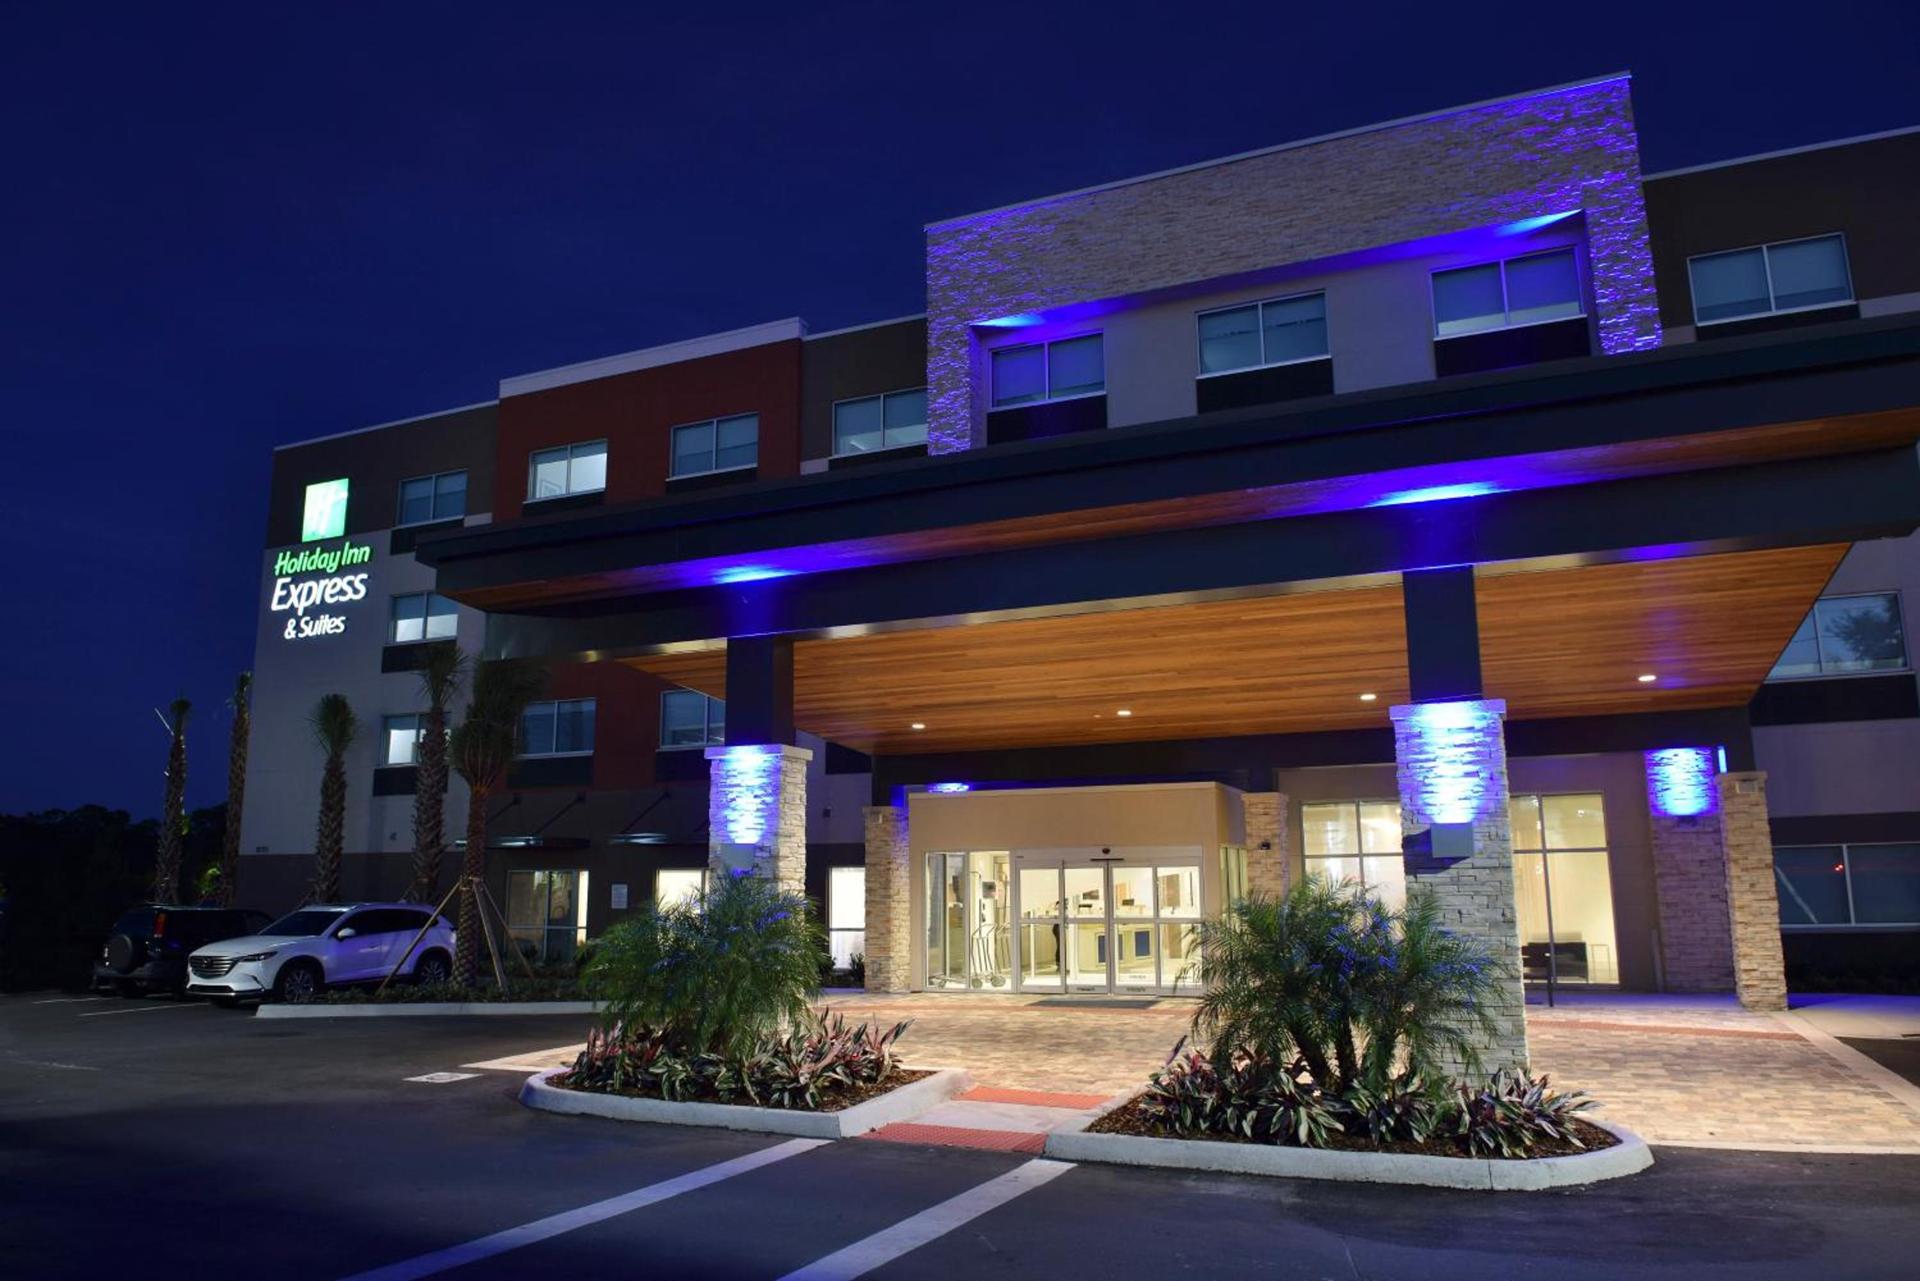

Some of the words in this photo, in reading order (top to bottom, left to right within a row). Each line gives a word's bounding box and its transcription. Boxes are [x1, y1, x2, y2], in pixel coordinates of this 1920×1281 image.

[274, 546, 341, 576] Holiday
[341, 542, 371, 565] Inn
[270, 573, 369, 616] Express
[284, 618, 296, 639] &
[298, 614, 346, 638] Suites
